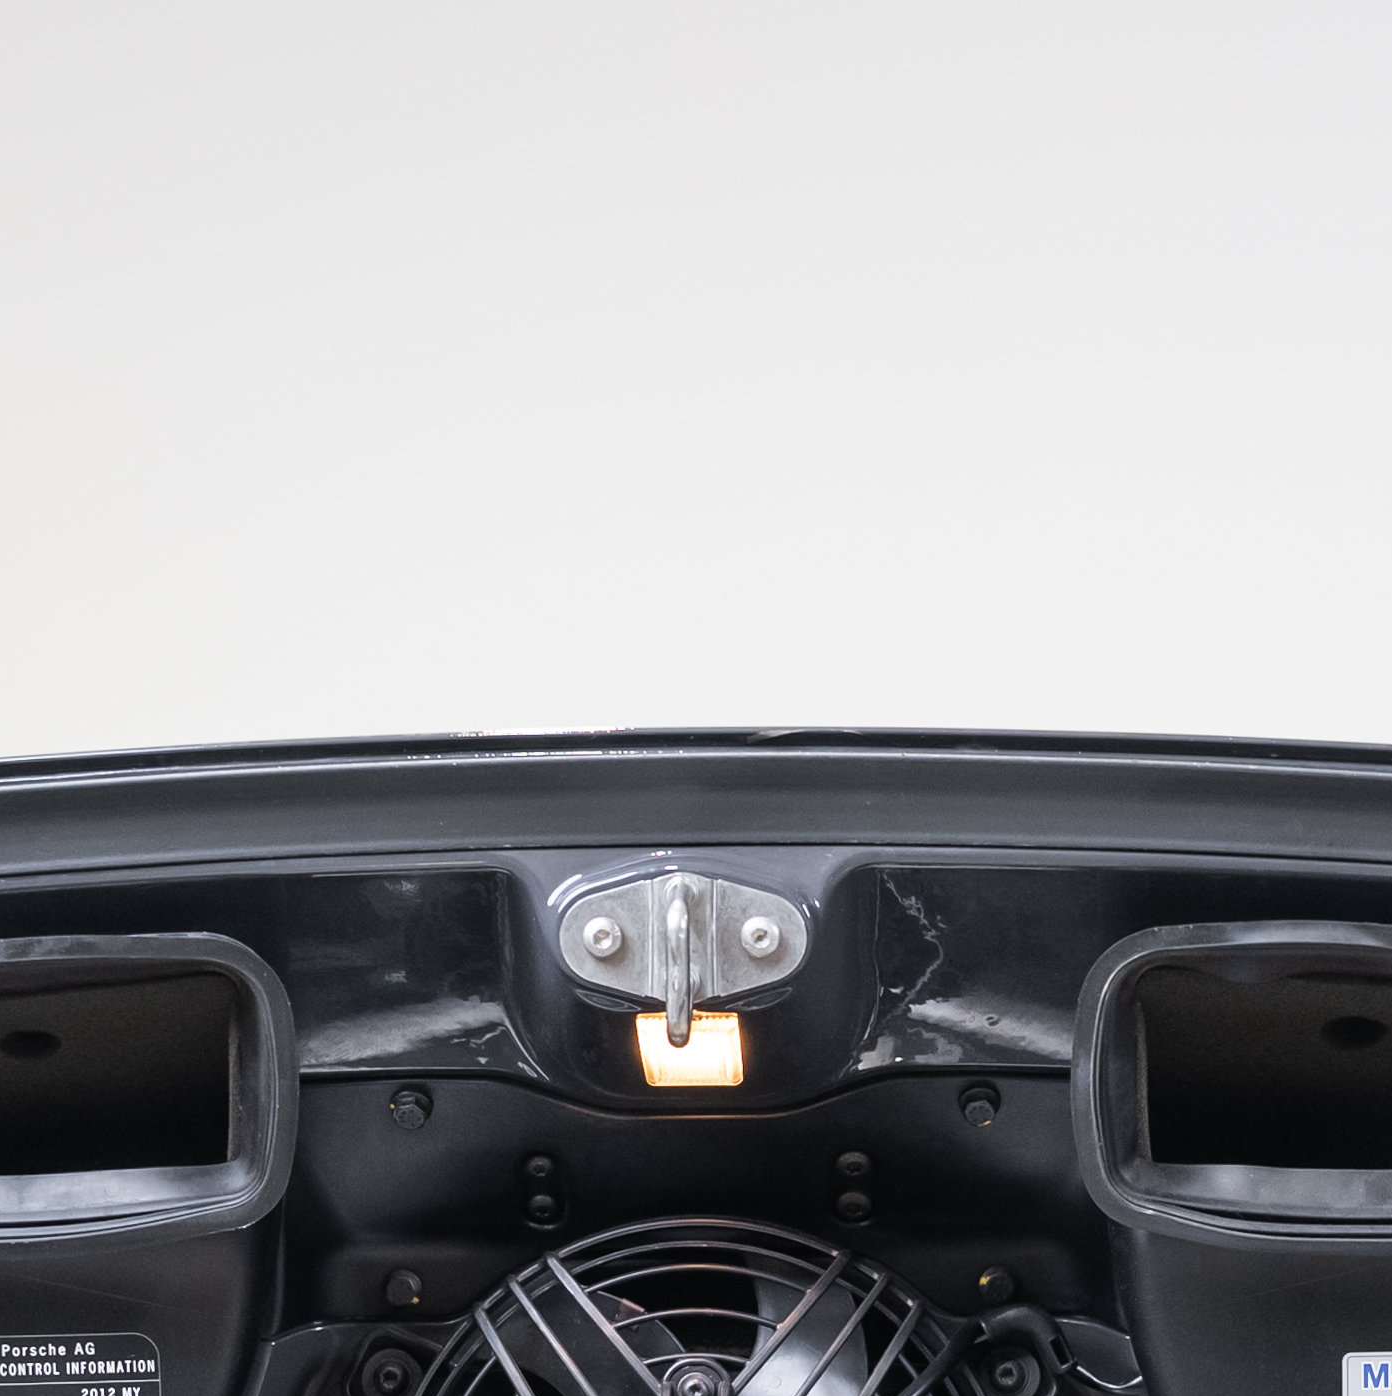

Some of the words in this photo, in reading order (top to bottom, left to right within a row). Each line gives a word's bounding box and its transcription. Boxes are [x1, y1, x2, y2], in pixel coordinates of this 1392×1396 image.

[1, 1344, 67, 1357] Porsche
[75, 1343, 95, 1356] AG
[0, 1362, 60, 1376] CONTROL
[66, 1359, 155, 1375] INFORMATION
